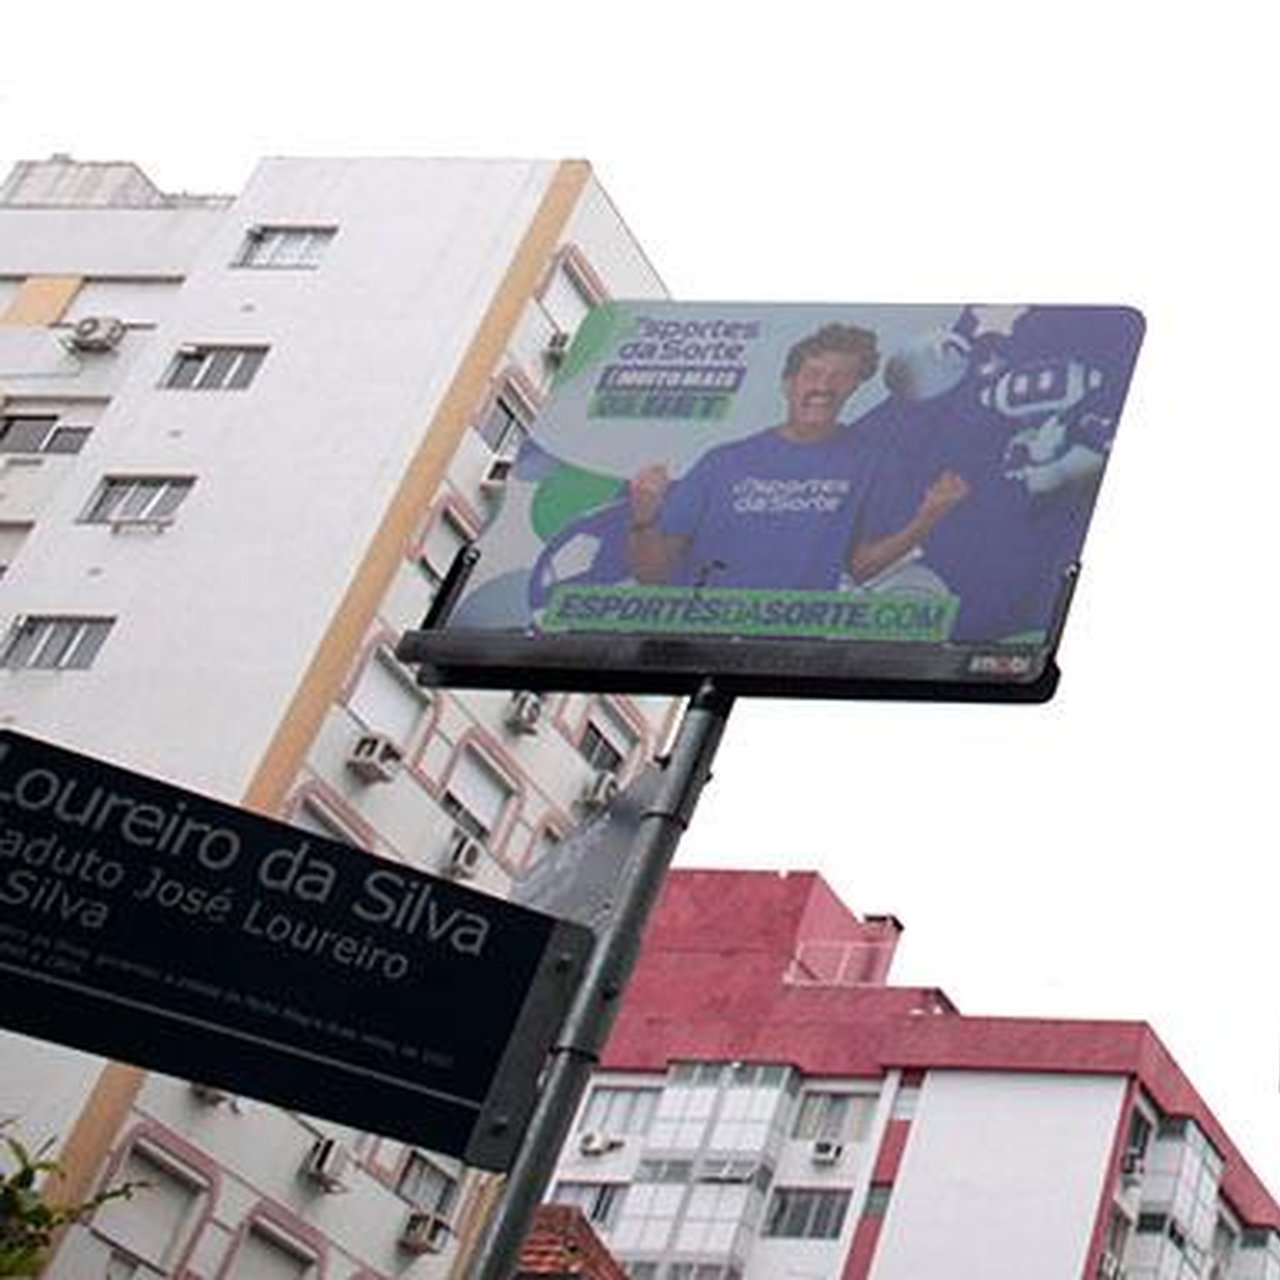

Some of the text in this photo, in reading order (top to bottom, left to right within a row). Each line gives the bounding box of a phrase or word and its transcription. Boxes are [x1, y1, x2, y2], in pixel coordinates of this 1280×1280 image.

[634, 316, 762, 340] sportes
[0, 869, 110, 929] Silva
[132, 865, 233, 923] José
[242, 899, 409, 980] Loureiro
[257, 840, 338, 904] da
[351, 869, 491, 957] Silva
